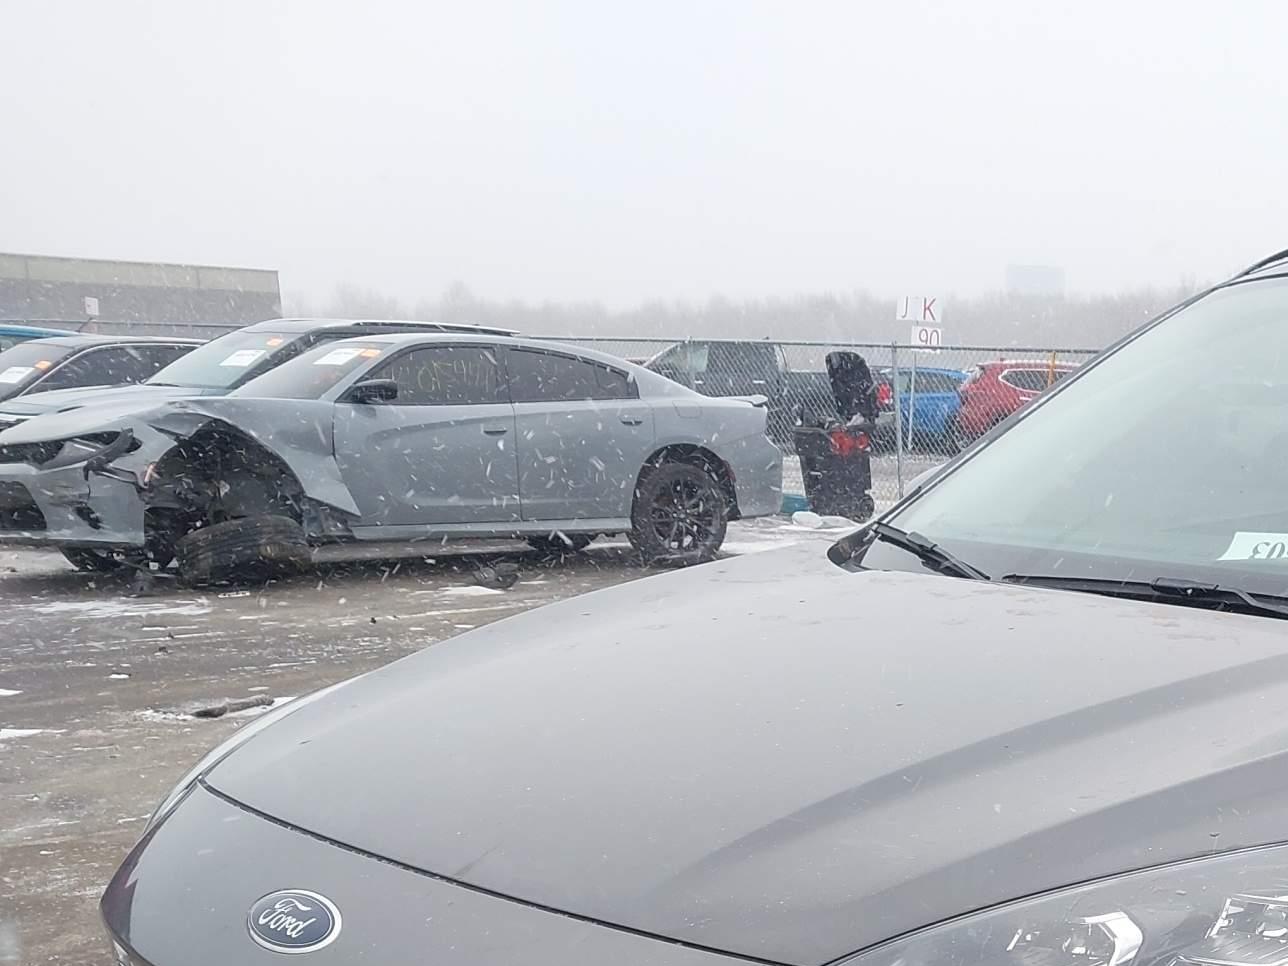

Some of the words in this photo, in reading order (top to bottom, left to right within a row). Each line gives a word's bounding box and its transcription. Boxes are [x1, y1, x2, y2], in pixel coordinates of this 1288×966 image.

[901, 295, 909, 319] J
[923, 296, 936, 321] K
[918, 328, 940, 350] 90
[258, 898, 317, 939] Ford
